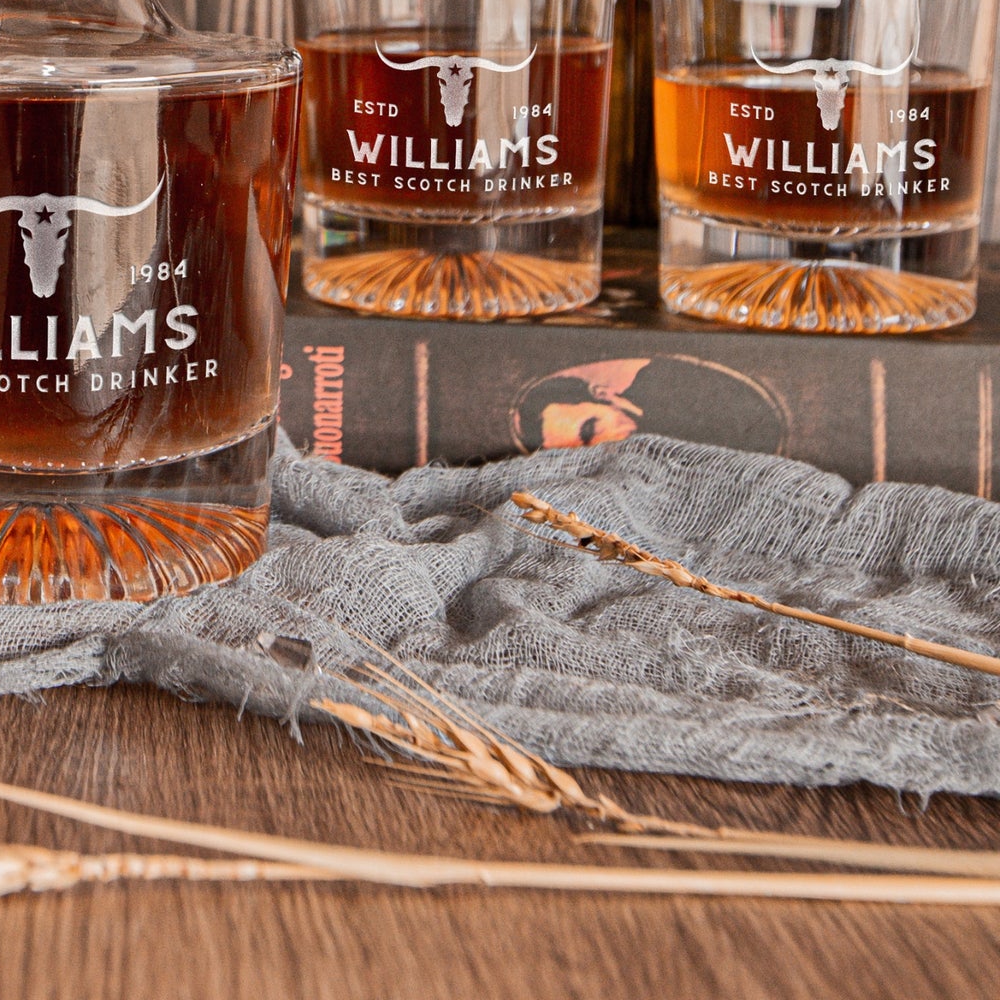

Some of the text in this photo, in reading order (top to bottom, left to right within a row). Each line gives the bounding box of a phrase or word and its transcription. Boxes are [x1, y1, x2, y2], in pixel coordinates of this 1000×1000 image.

[354, 99, 552, 120] ESTD 1984
[729, 103, 930, 124] ESTD 1984
[346, 129, 560, 170] WILLIAMS
[723, 132, 937, 175] WILLIAMS
[331, 168, 573, 193] BEST SCOTCH DRINKER
[708, 170, 950, 197] BEST SCOTCH DRINKER
[130, 259, 188, 285] 1984
[90, 359, 219, 392] DRINKER
[303, 345, 344, 463] uonarroti
